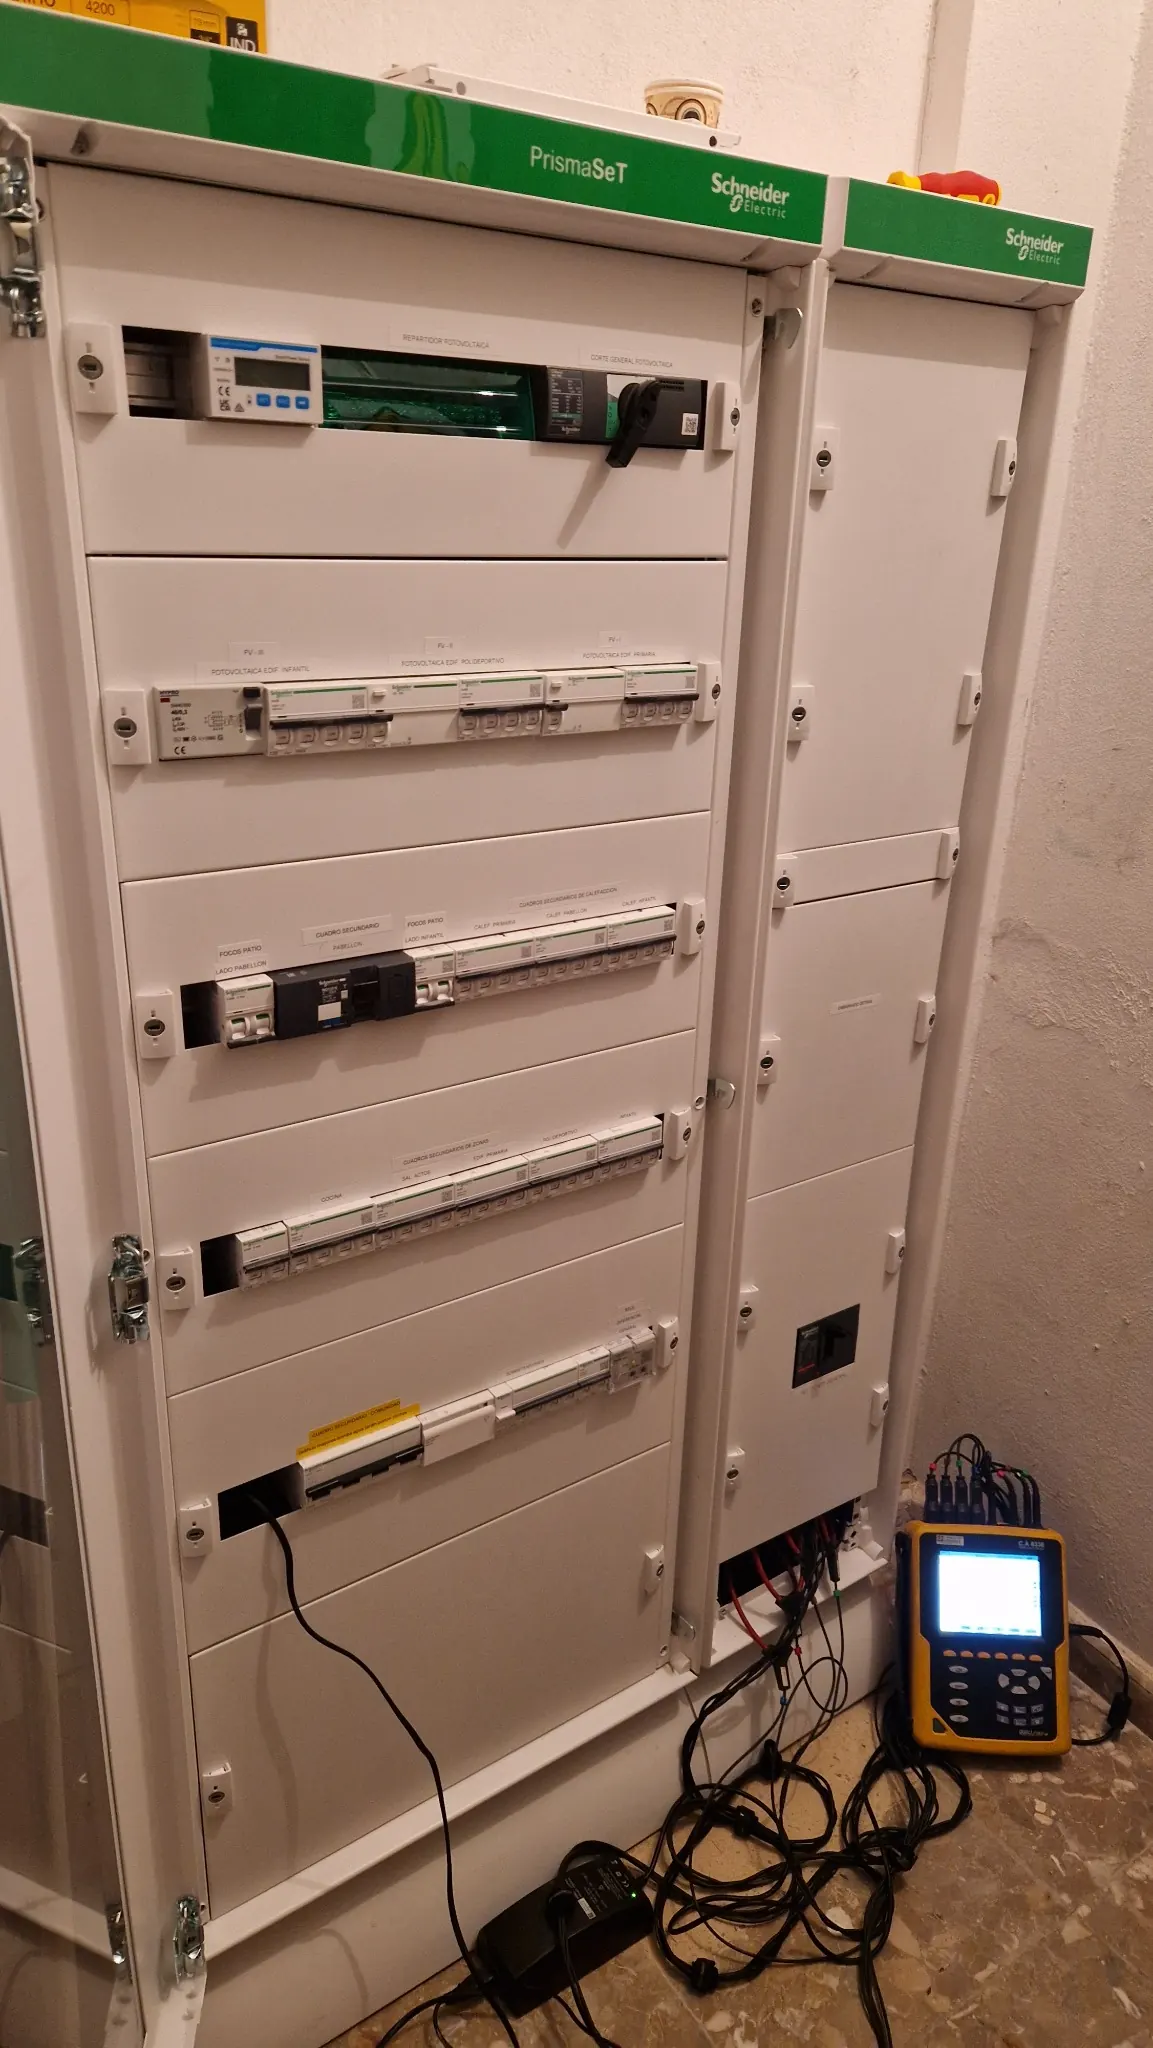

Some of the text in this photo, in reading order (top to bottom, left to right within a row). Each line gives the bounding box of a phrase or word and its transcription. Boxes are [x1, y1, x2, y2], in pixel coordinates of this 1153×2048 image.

[86, 0, 115, 16] 4200
[530, 145, 628, 184] PrismaSeT
[711, 172, 789, 205] Schneider
[744, 200, 786, 218] Electric
[1005, 227, 1064, 254] Schneider
[1029, 249, 1060, 265] Electric
[211, 667, 262, 676] FOTOVOLTAICA
[282, 665, 310, 673] INFANTIL
[315, 922, 380, 938] CUADRO SECUNDARIO
[407, 917, 444, 928] FOCOS PATIO
[405, 935, 419, 943] LADO
[219, 945, 262, 958] FOCOS PATIO
[215, 960, 267, 975] LADO PABELLON
